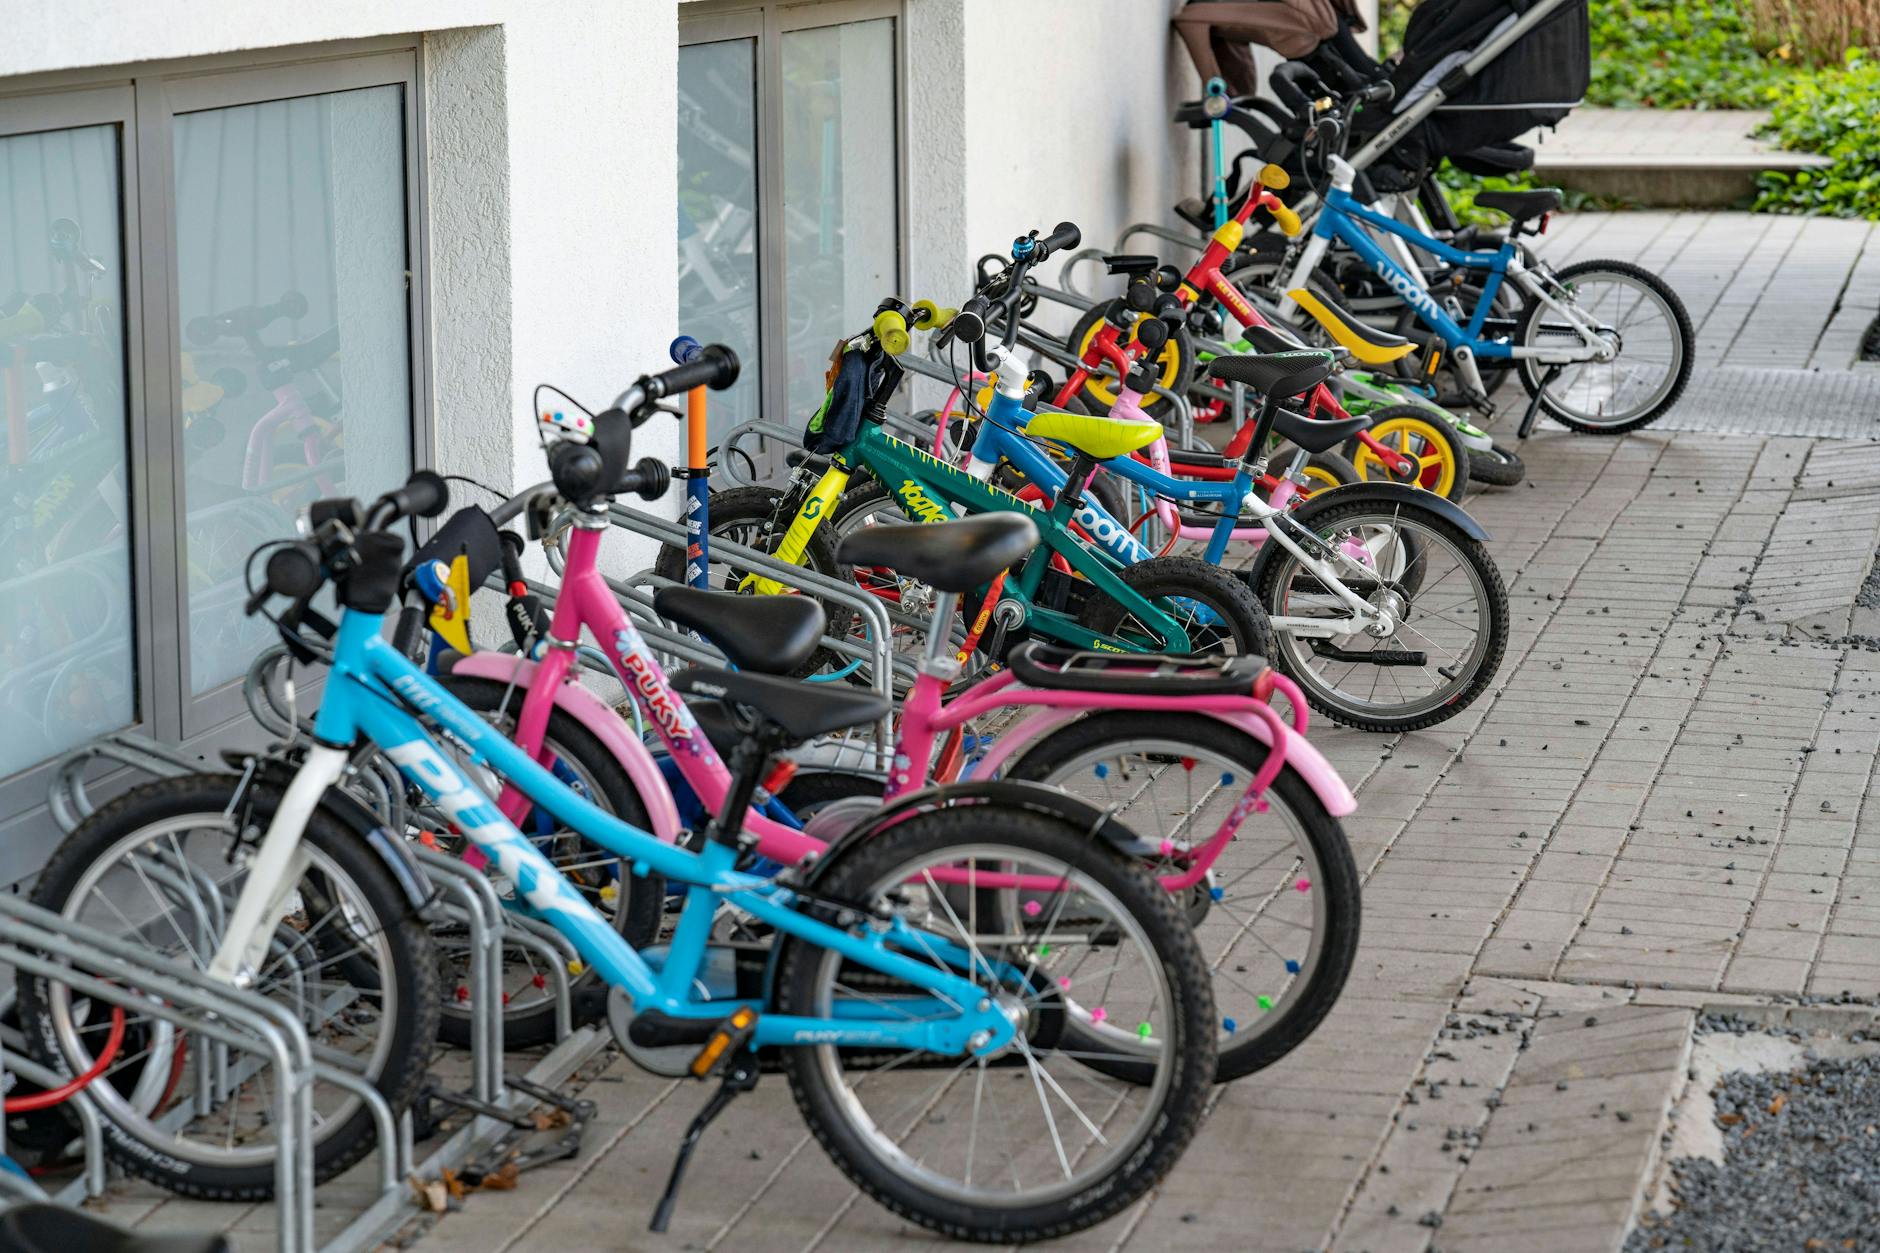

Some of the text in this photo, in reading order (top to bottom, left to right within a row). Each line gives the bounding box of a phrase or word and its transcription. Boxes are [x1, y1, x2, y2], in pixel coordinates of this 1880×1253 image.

[1377, 261, 1438, 320] woom
[513, 603, 538, 636] PUKY
[622, 653, 692, 738] PUKY
[384, 739, 606, 925] PUKY
